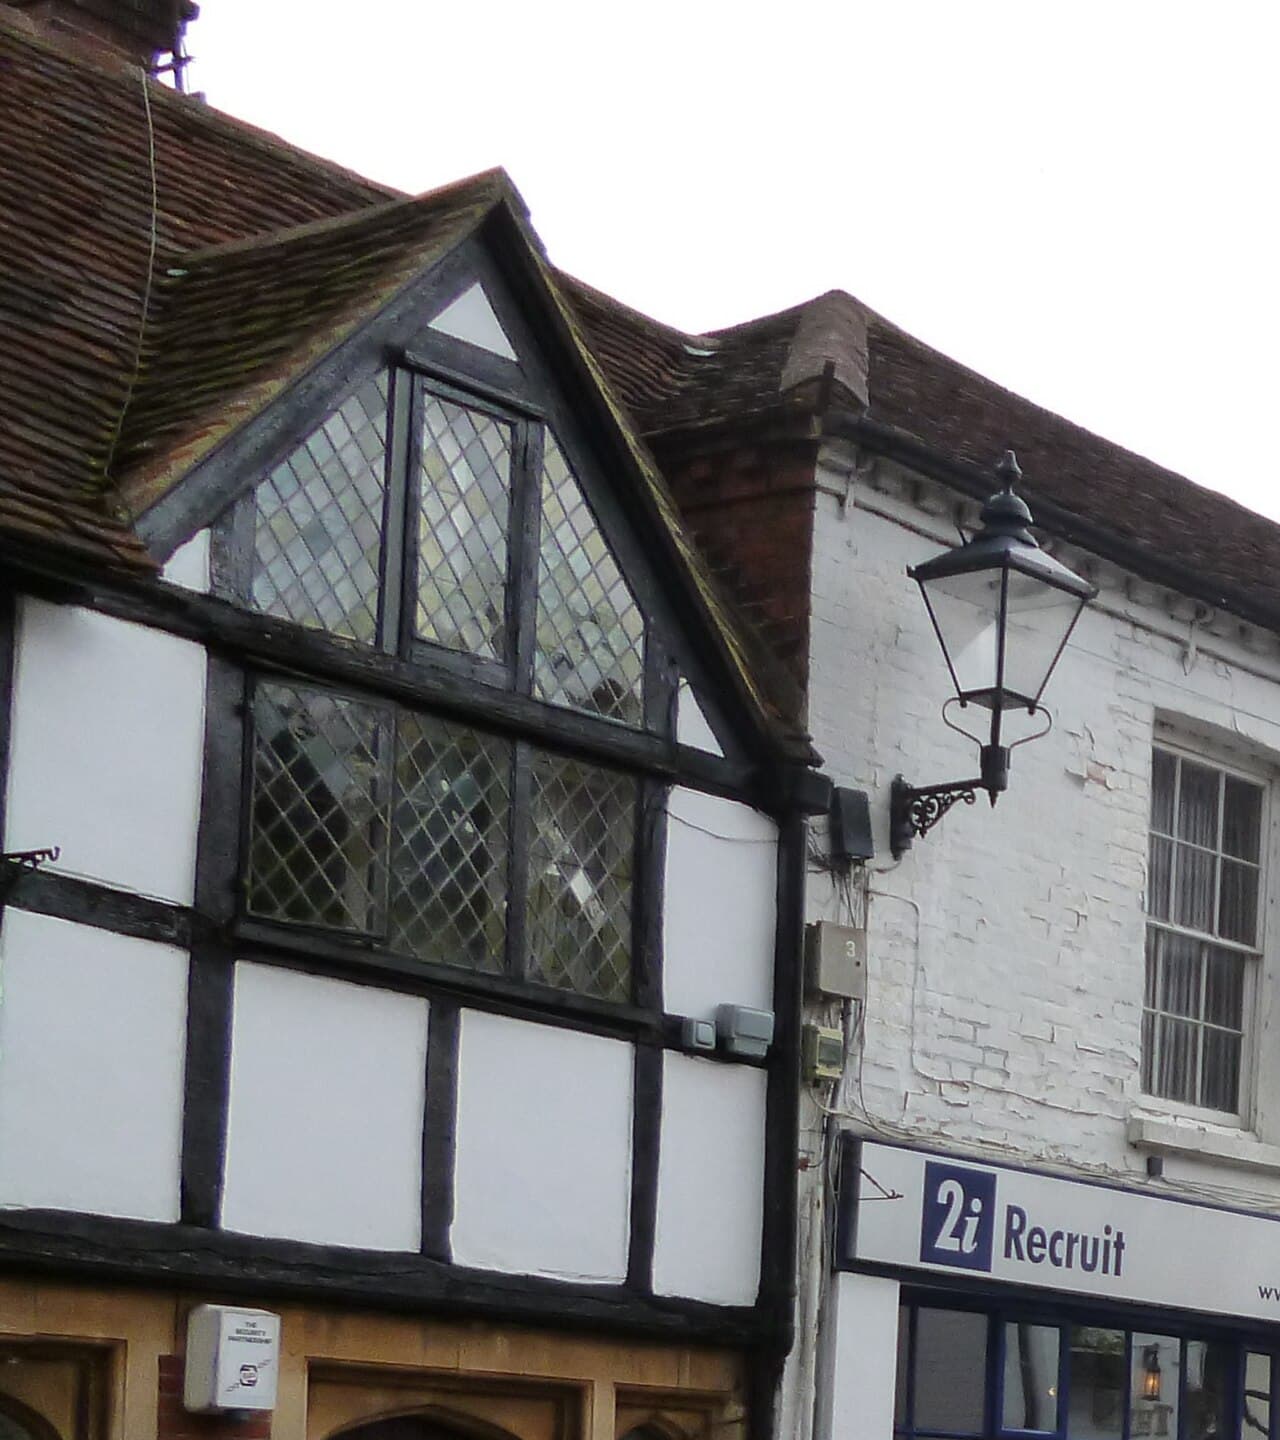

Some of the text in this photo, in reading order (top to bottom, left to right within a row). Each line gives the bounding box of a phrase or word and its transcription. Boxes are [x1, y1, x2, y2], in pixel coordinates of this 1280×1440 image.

[845, 940, 856, 957] 3
[934, 1179, 1126, 1277] 2i Recruit
